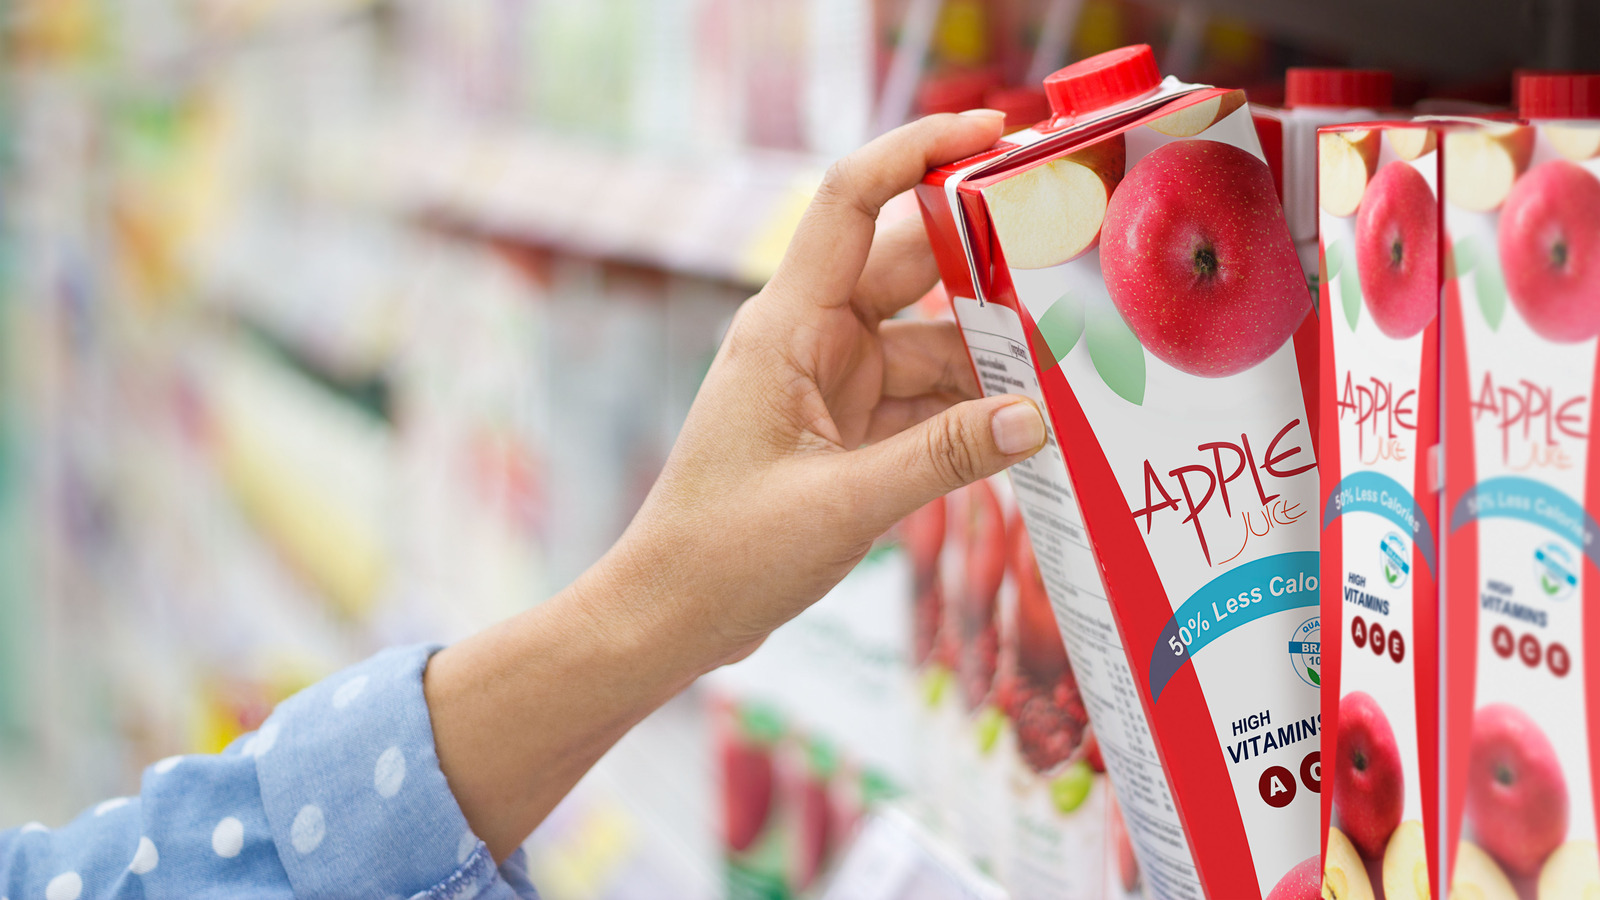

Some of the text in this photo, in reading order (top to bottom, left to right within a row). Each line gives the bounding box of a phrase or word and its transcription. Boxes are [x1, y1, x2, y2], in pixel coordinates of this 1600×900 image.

[1337, 370, 1418, 463] APPLE
[1470, 370, 1589, 466] APPLE
[1132, 418, 1318, 567] APPLE
[1335, 486, 1420, 533] 50% Less Calories
[1218, 500, 1307, 565] JUICE
[1344, 586, 1390, 616] VITAMINS
[1348, 572, 1366, 588] HIGH
[1168, 572, 1319, 657] 50% Less Calo
[1481, 594, 1548, 628] VITAMINS
[1227, 713, 1320, 764] VITAMIN
[1232, 710, 1271, 736] HIGH
[1270, 775, 1288, 797] A
